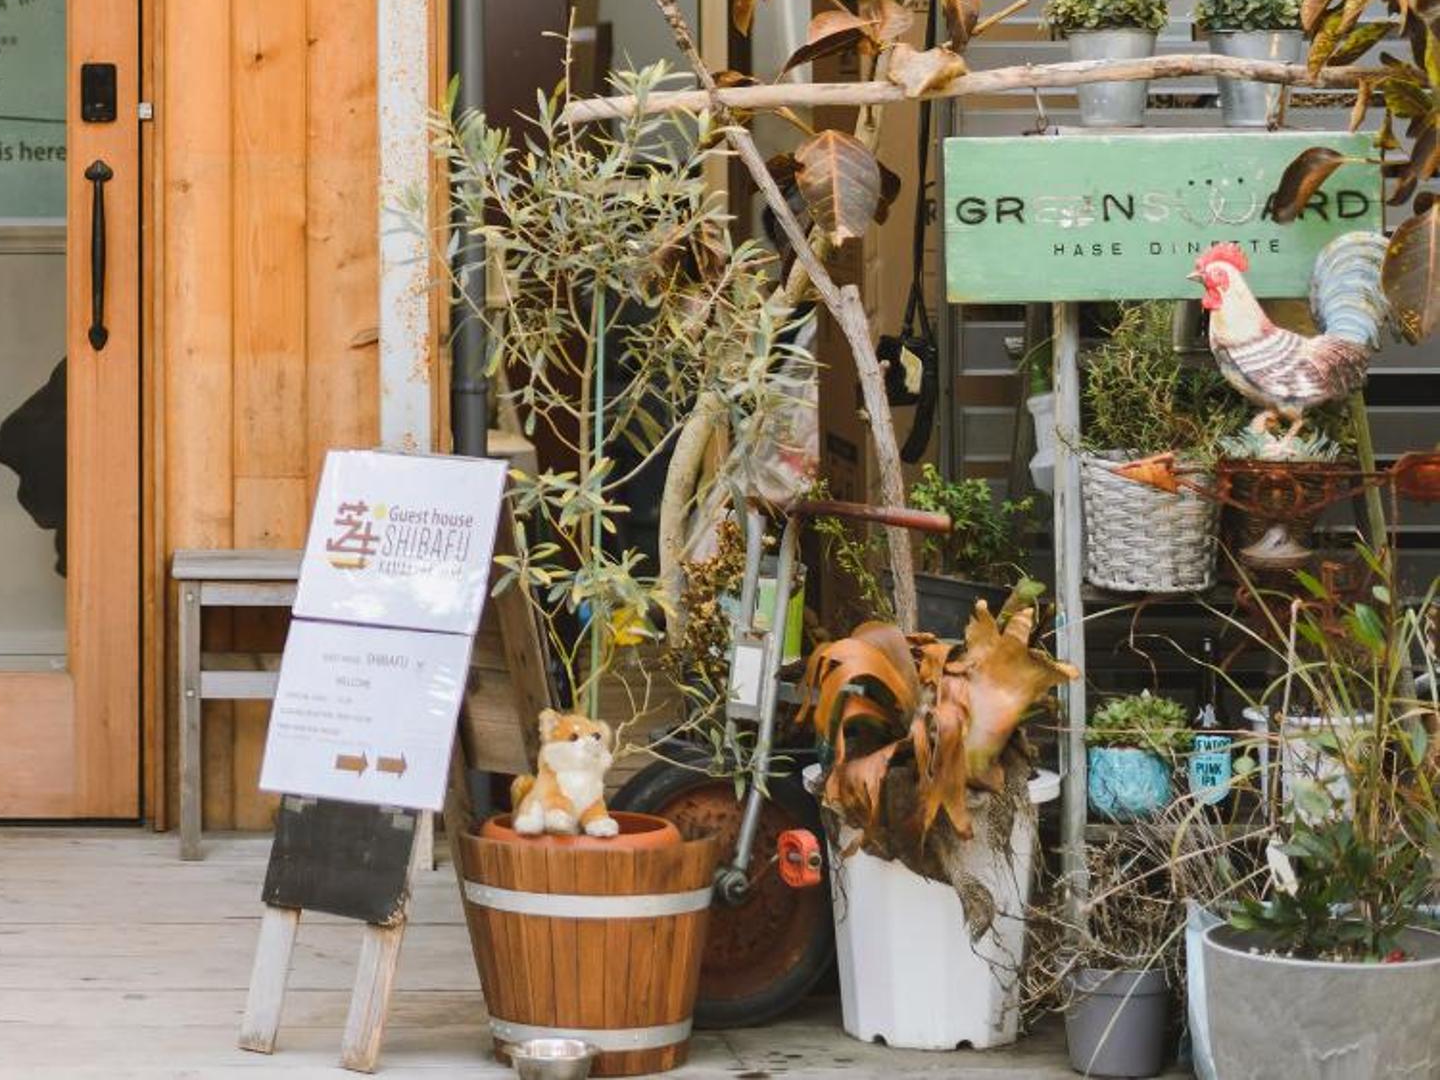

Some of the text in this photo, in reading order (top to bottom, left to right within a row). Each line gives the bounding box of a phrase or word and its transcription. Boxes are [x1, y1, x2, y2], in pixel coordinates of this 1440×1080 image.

[1053, 239, 1281, 257] HASE DINTE
[388, 505, 474, 528] Guest house
[380, 524, 472, 563] SHIBAFU
